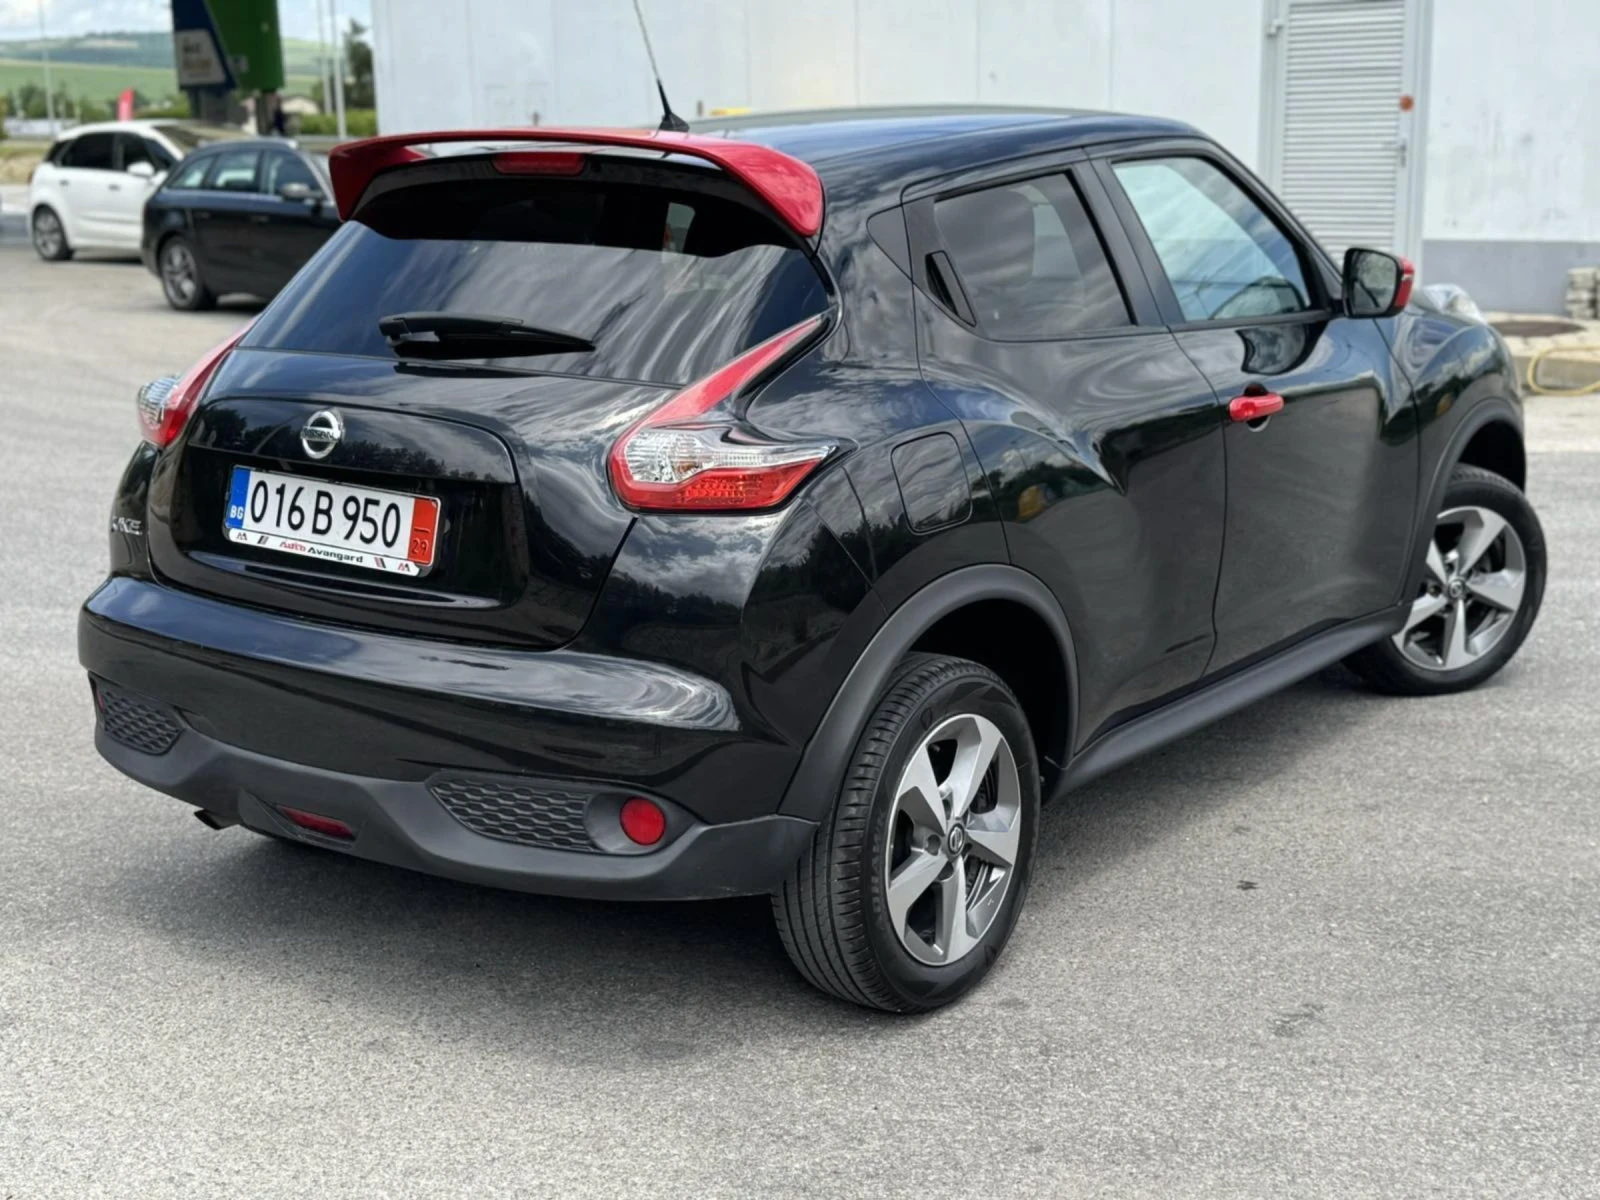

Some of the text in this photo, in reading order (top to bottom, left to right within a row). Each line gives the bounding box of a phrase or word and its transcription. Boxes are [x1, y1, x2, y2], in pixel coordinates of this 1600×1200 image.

[230, 505, 244, 520] BG
[411, 537, 429, 556] 29
[308, 547, 363, 563] Avangard
